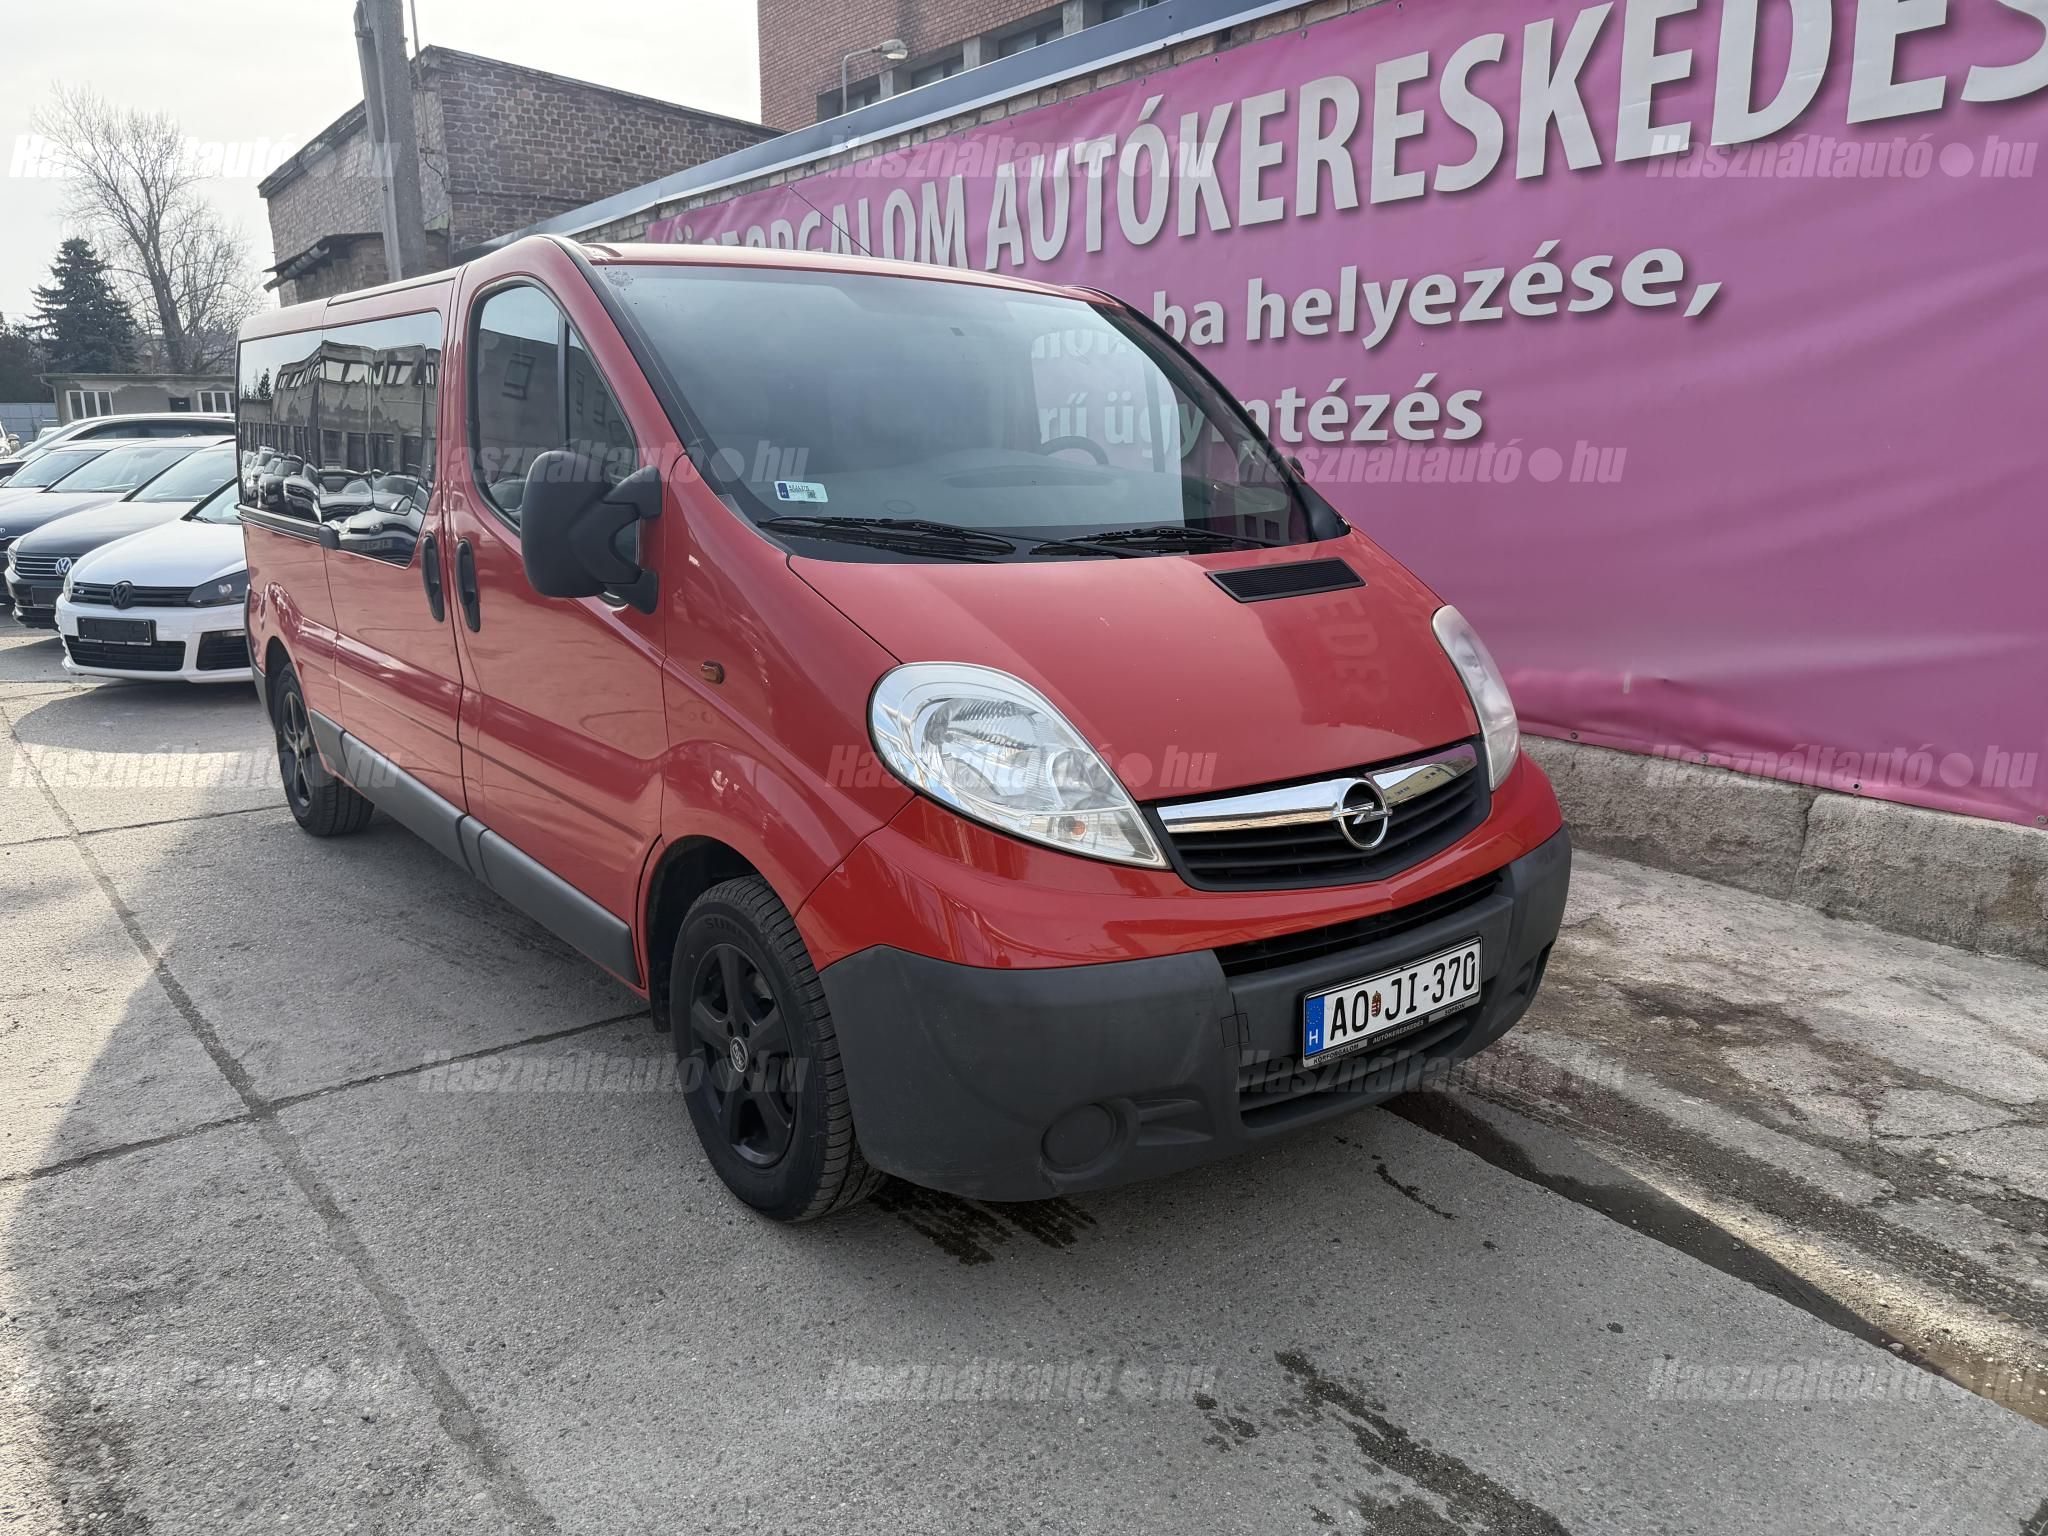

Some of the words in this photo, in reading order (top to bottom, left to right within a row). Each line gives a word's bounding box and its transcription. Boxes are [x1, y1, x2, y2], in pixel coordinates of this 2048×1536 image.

[1247, 240, 1722, 349] helyezése,
[1308, 1028, 1319, 1047] H
[1330, 989, 1369, 1041] AO
